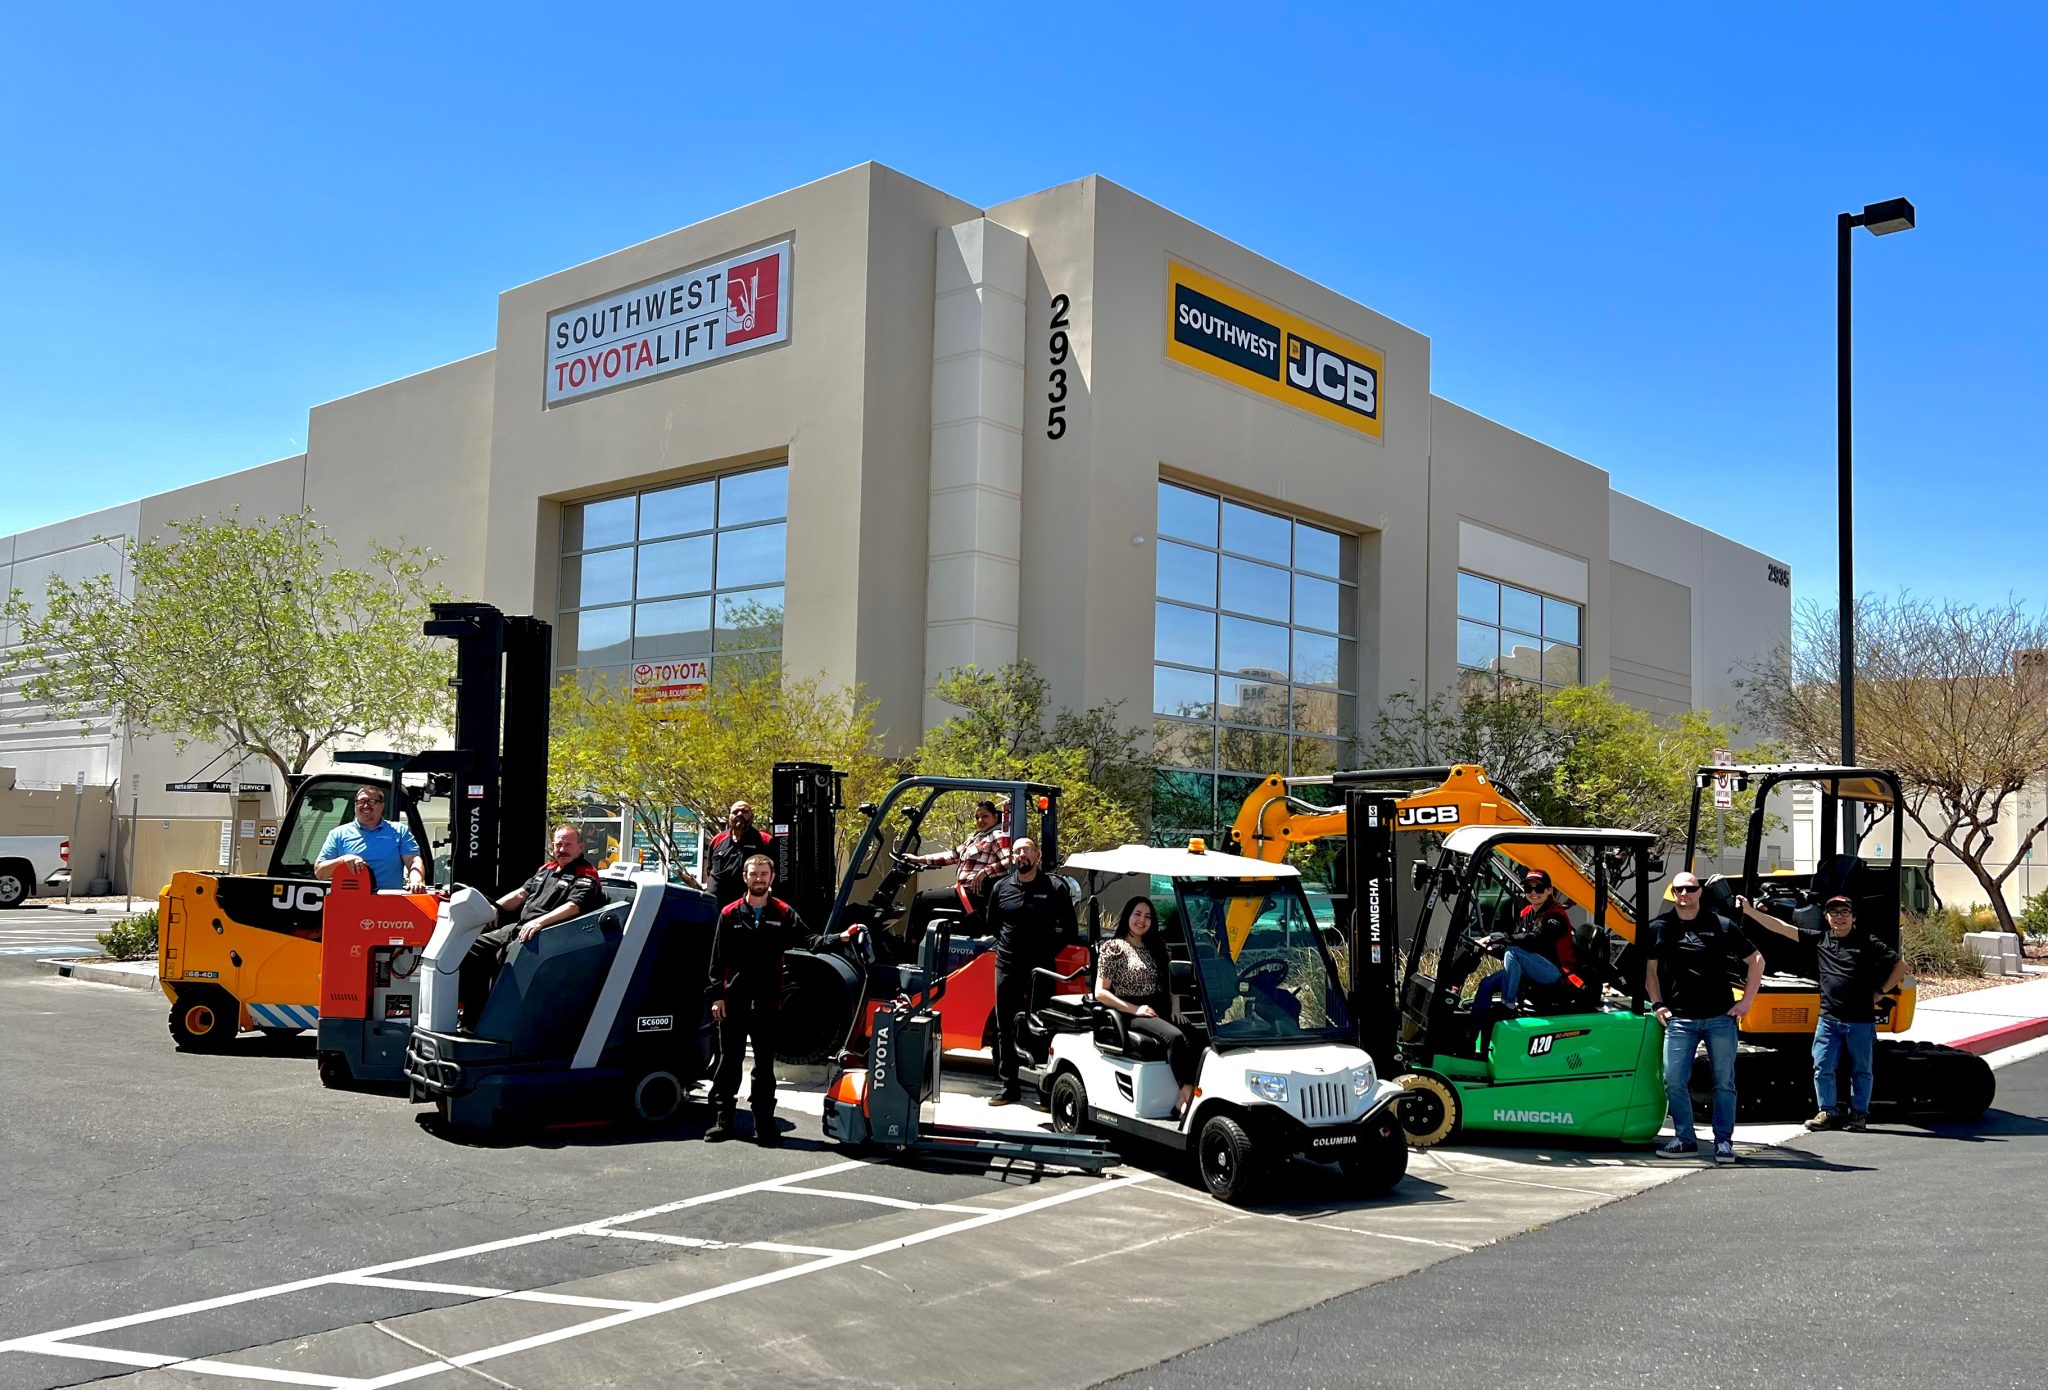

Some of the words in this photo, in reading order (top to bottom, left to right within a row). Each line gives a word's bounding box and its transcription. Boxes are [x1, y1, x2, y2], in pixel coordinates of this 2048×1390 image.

[556, 273, 721, 349] SOUTHWEST
[555, 318, 719, 391] TOYOTALIFT
[1179, 303, 1277, 361] SOUTHWEST
[1289, 345, 1375, 413] JCB
[1047, 294, 1070, 440] 2935
[1768, 564, 1790, 588] 2935
[655, 663, 707, 681] TOYOTA
[240, 783, 265, 791] SERVICE
[1399, 805, 1458, 825] JCB
[260, 827, 276, 837] JCB
[469, 806, 480, 858] TOYOTA
[780, 837, 788, 882] TOYOTA
[272, 885, 331, 911] JC
[1369, 878, 1381, 942] HANGCHA
[377, 920, 414, 929] TOYOTA
[642, 1018, 669, 1026] SC6000
[1530, 1035, 1552, 1055] A20
[874, 1027, 889, 1090] TOYOTA
[1494, 1109, 1574, 1124] HANGCHA
[1313, 1136, 1357, 1147] COLUMBIA
